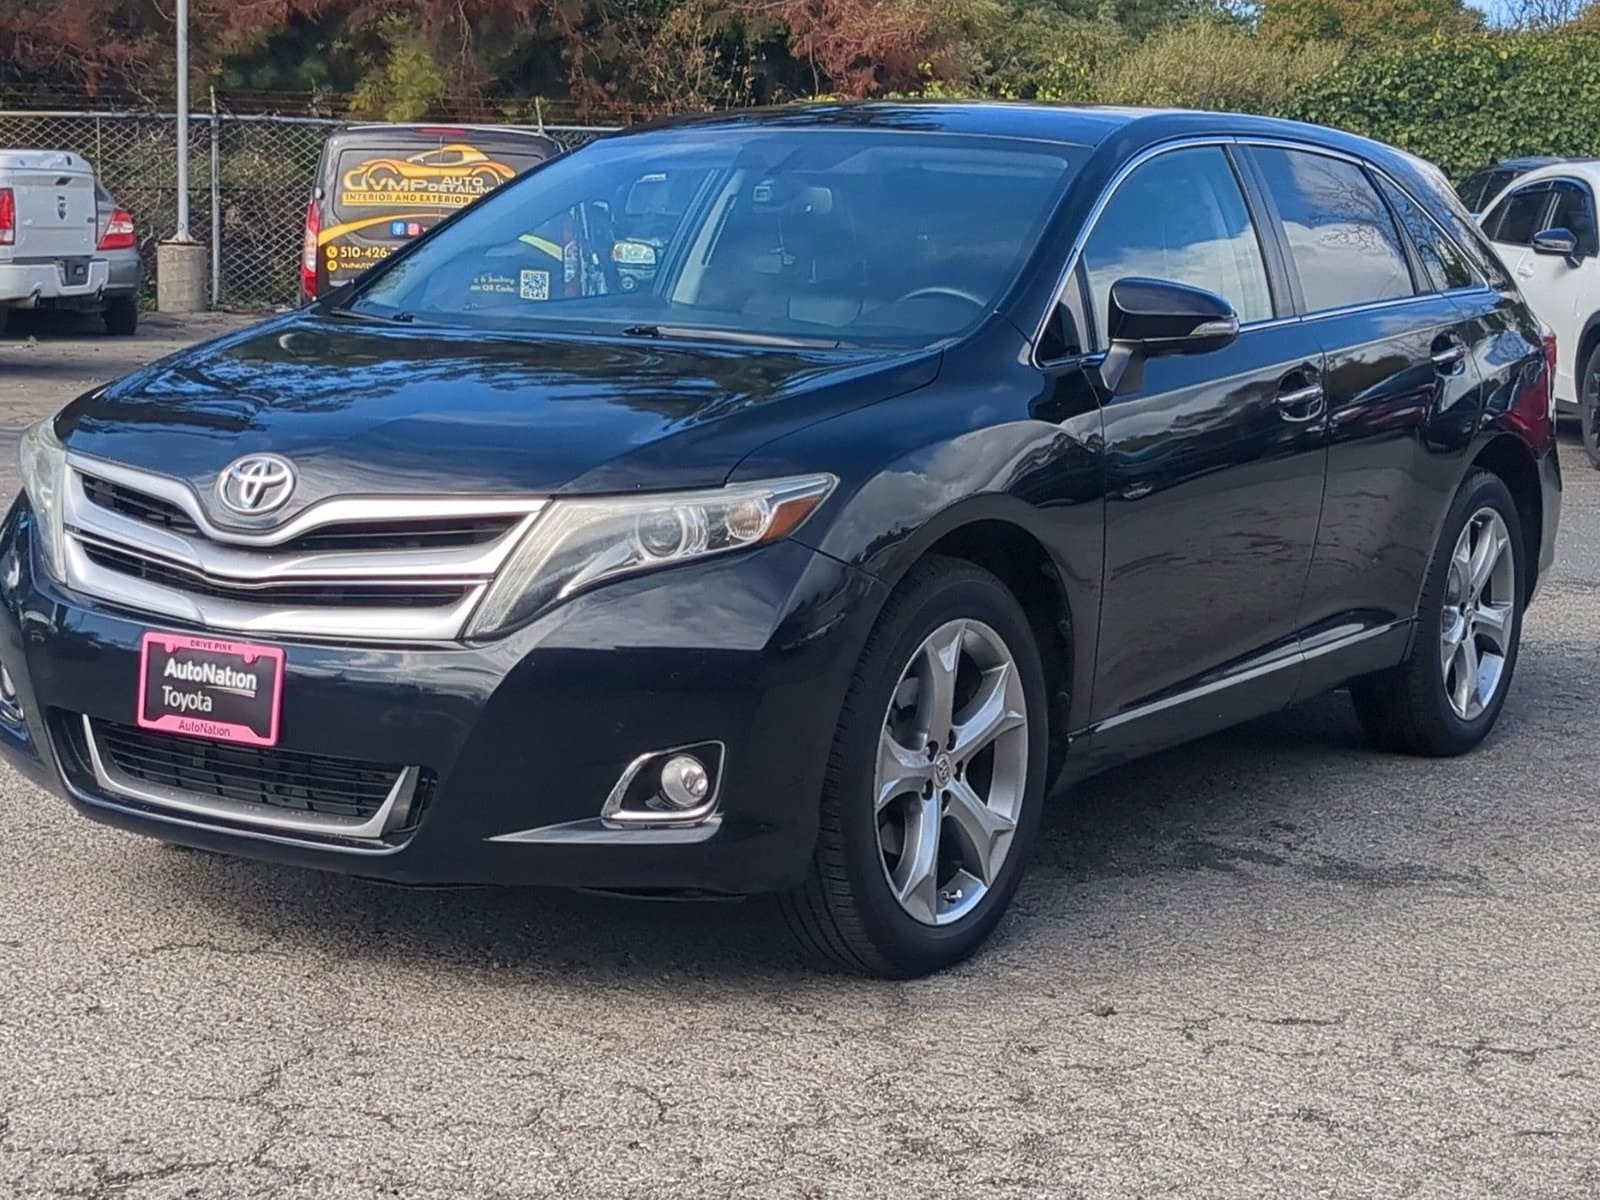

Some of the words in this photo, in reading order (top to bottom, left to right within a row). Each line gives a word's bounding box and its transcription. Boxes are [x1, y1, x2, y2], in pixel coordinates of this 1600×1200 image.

[442, 176, 484, 186] AUTO
[345, 193, 393, 201] INTERIOR
[395, 194, 416, 202] AND
[419, 194, 469, 203] EXTERIOR
[190, 639, 212, 648] DRIVE
[214, 643, 233, 651] PINK
[164, 658, 257, 690] AutoNation
[161, 685, 213, 713] Toyota
[178, 719, 231, 737] AutoNation
